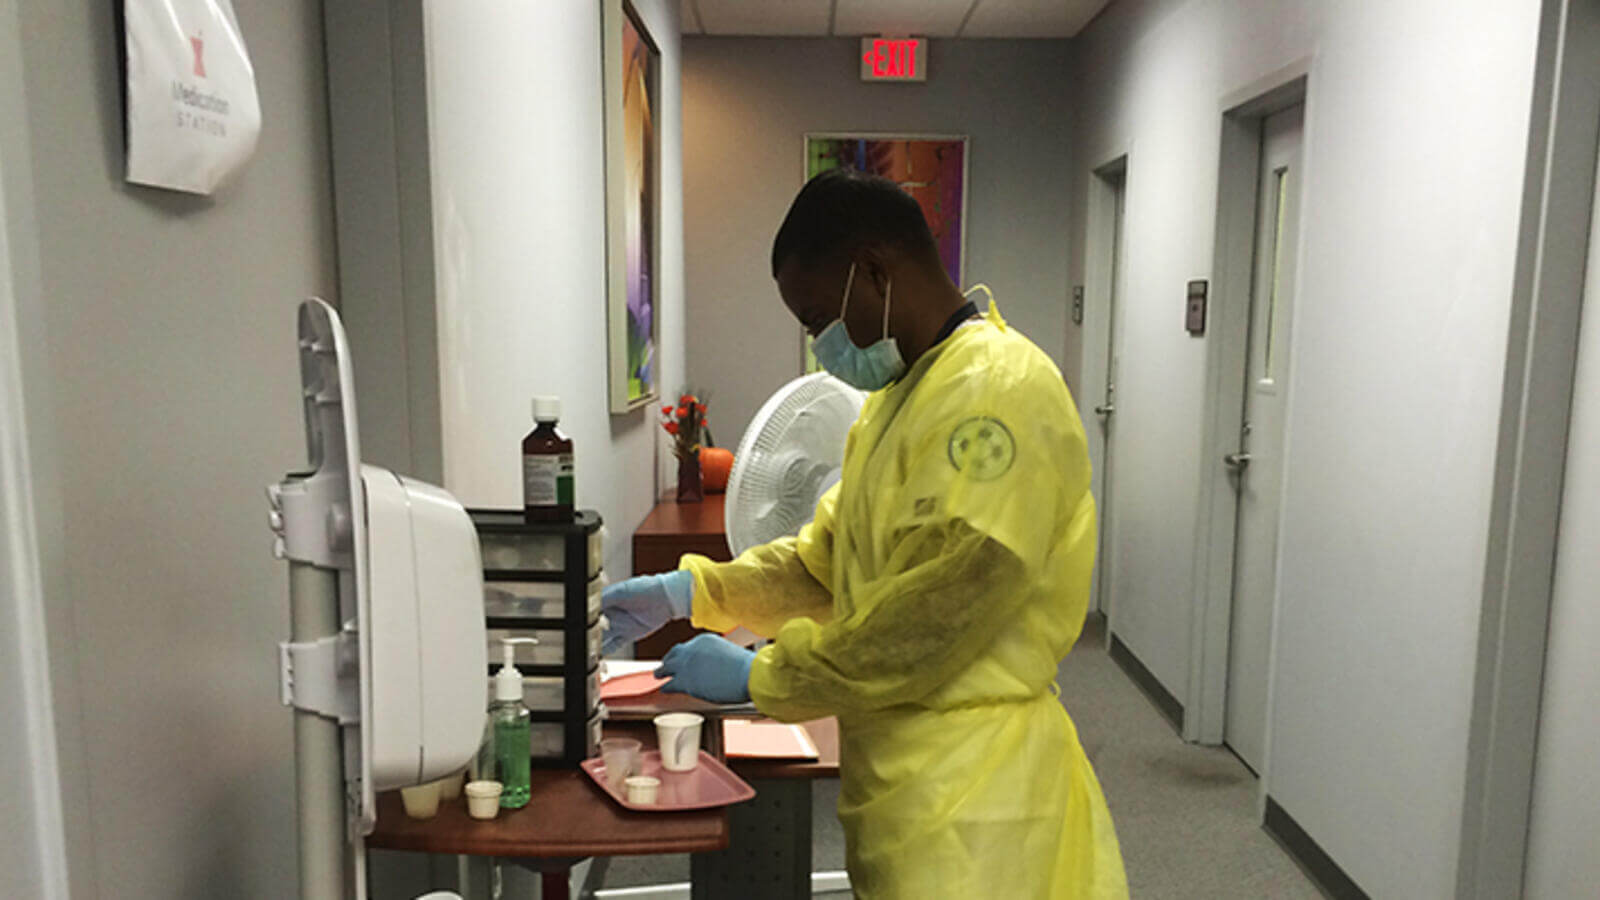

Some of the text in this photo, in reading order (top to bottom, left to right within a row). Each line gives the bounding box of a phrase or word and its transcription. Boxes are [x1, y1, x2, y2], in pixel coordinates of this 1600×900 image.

[873, 40, 919, 77] EXIT
[172, 80, 229, 114] Medication
[177, 111, 227, 136] STATION
